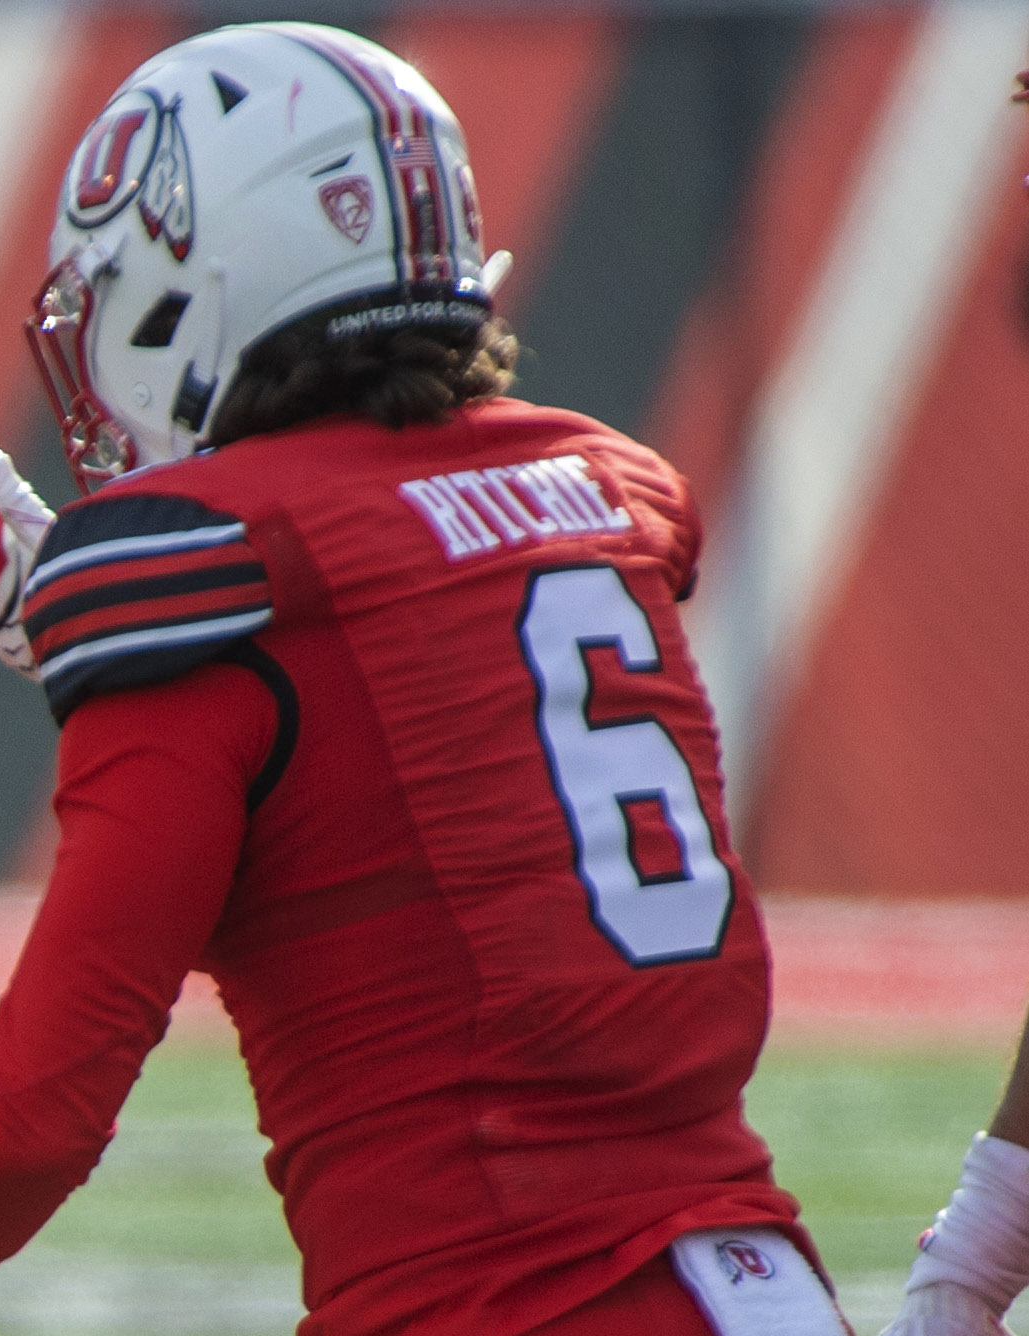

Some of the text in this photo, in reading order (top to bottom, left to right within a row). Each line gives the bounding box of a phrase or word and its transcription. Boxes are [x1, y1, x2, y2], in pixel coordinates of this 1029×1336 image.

[329, 303, 407, 336] UNITED
[410, 300, 446, 319] FOR
[399, 453, 634, 559] RITCHIE
[515, 560, 736, 969] 6
